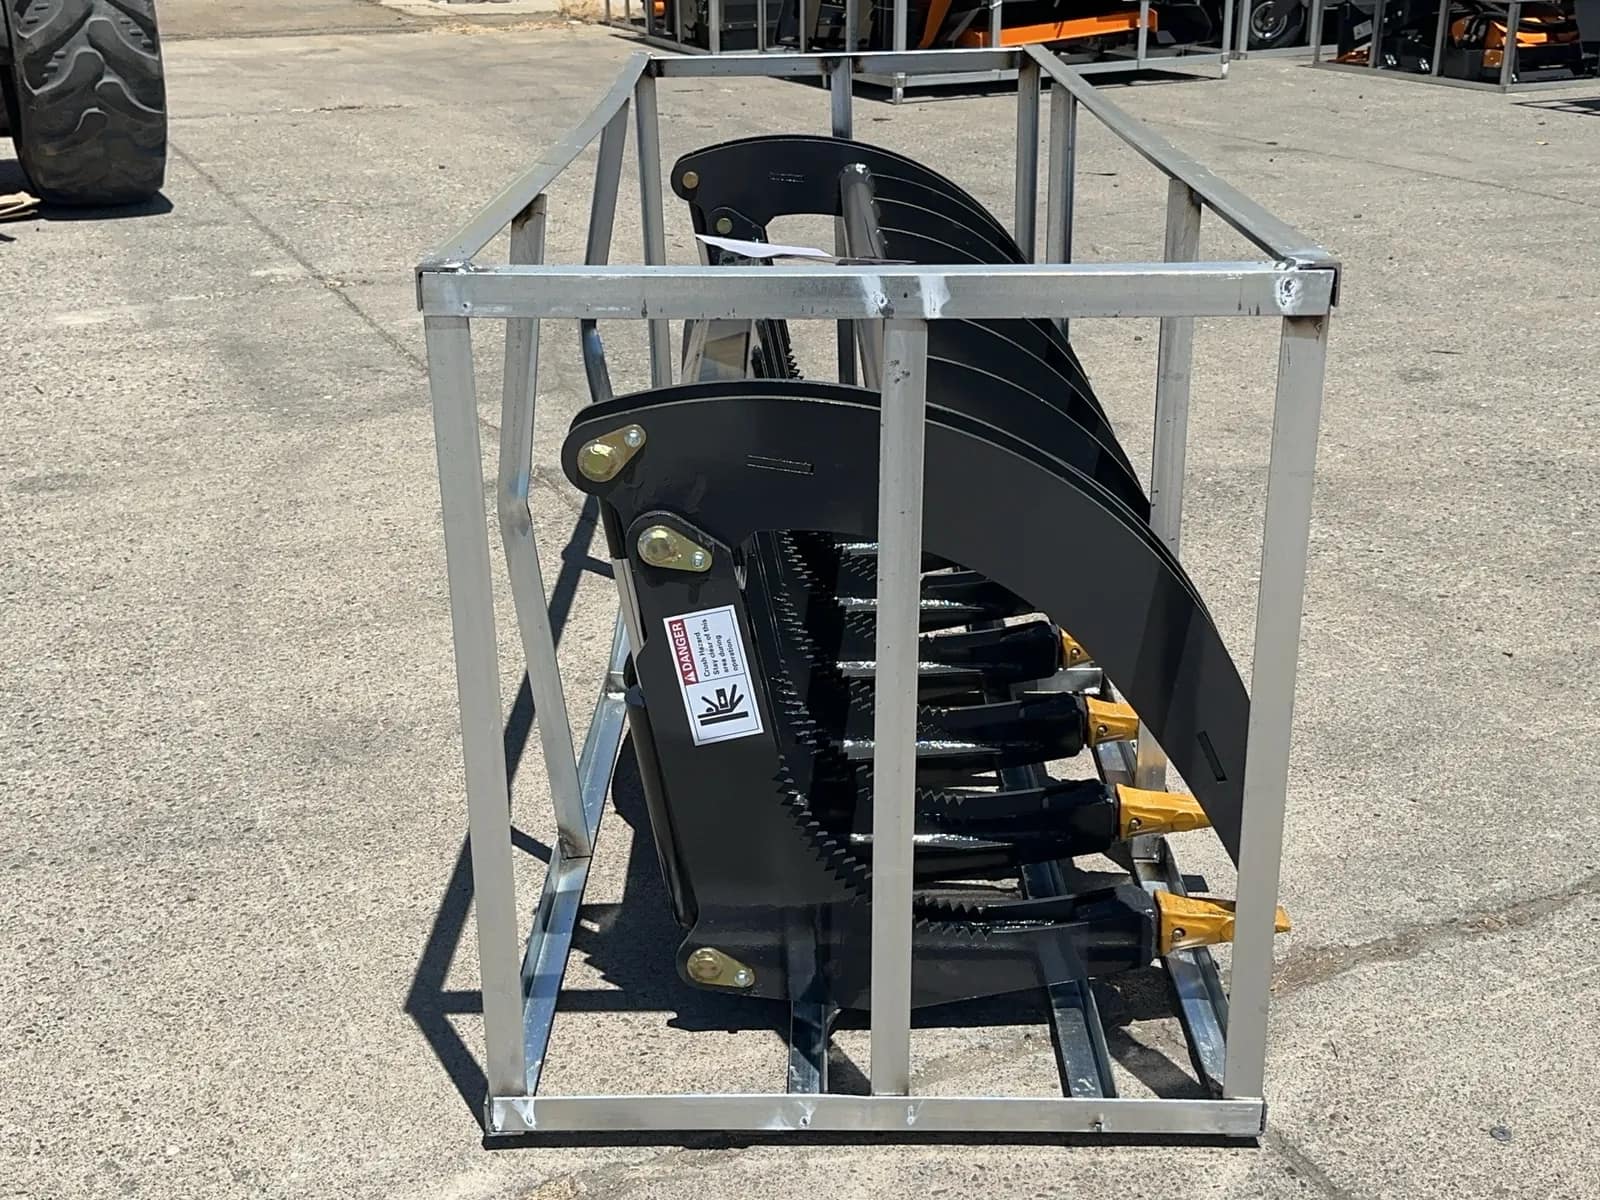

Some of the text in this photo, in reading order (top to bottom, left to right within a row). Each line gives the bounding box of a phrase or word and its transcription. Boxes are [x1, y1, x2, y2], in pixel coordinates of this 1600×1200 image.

[672, 622, 693, 671] DANGER
[694, 632, 711, 677] Crush Hazard
[702, 619, 720, 675] Stay clear of this
[716, 635, 726, 657] during
